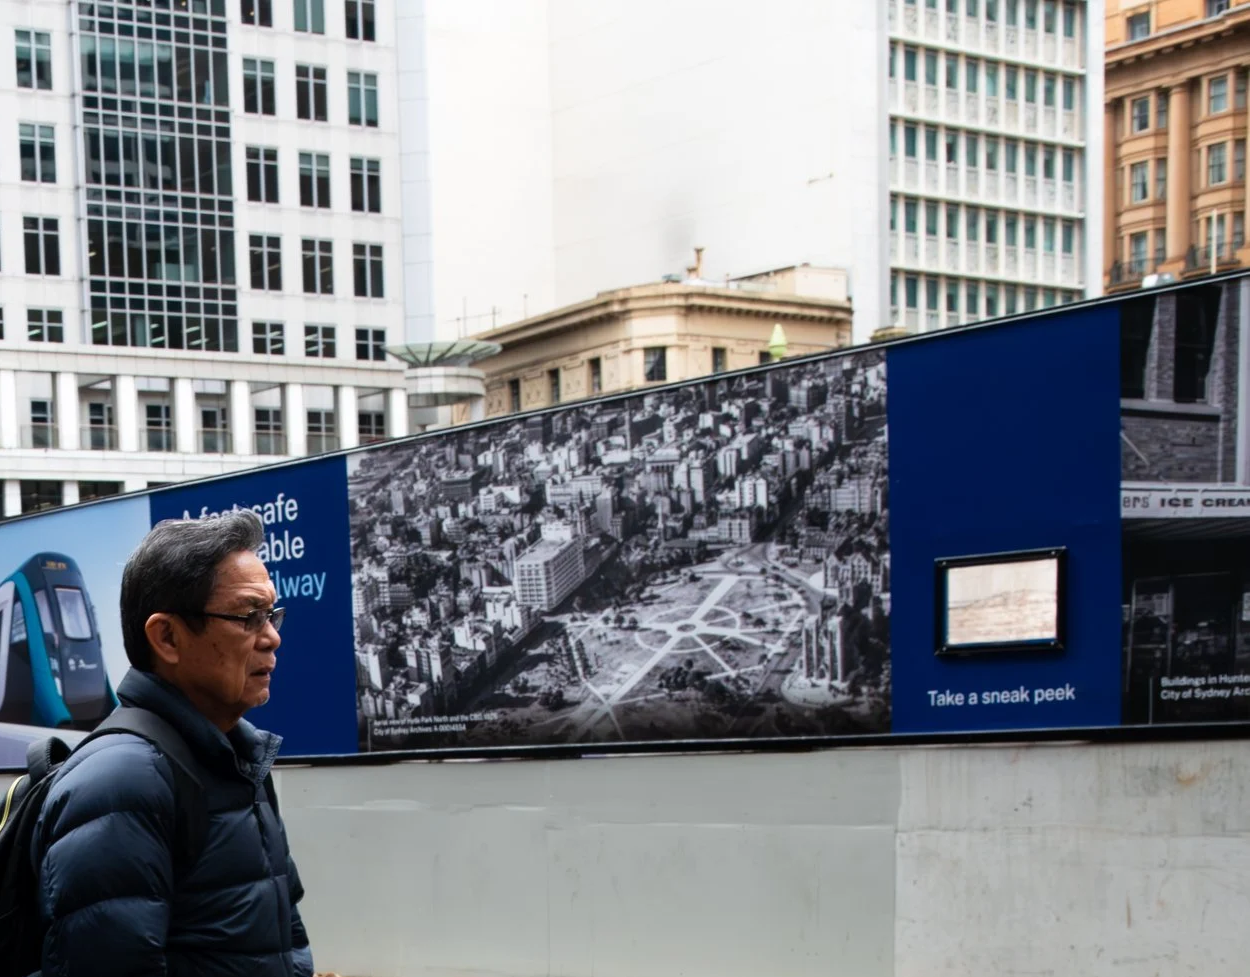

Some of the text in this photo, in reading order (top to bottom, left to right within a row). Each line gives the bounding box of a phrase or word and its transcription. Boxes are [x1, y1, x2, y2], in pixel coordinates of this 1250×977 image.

[1159, 498, 1194, 508] ICE
[1161, 674, 1250, 687] Buildings in Hunte
[927, 683, 1076, 706] Take a sneak peek
[1160, 689, 1180, 701] City
[1181, 688, 1192, 698] of
[1194, 687, 1231, 700] Sydney
[421, 715, 432, 723] Park
[433, 714, 448, 723] North
[449, 714, 459, 722] and
[460, 713, 469, 722] the
[373, 727, 384, 736] City
